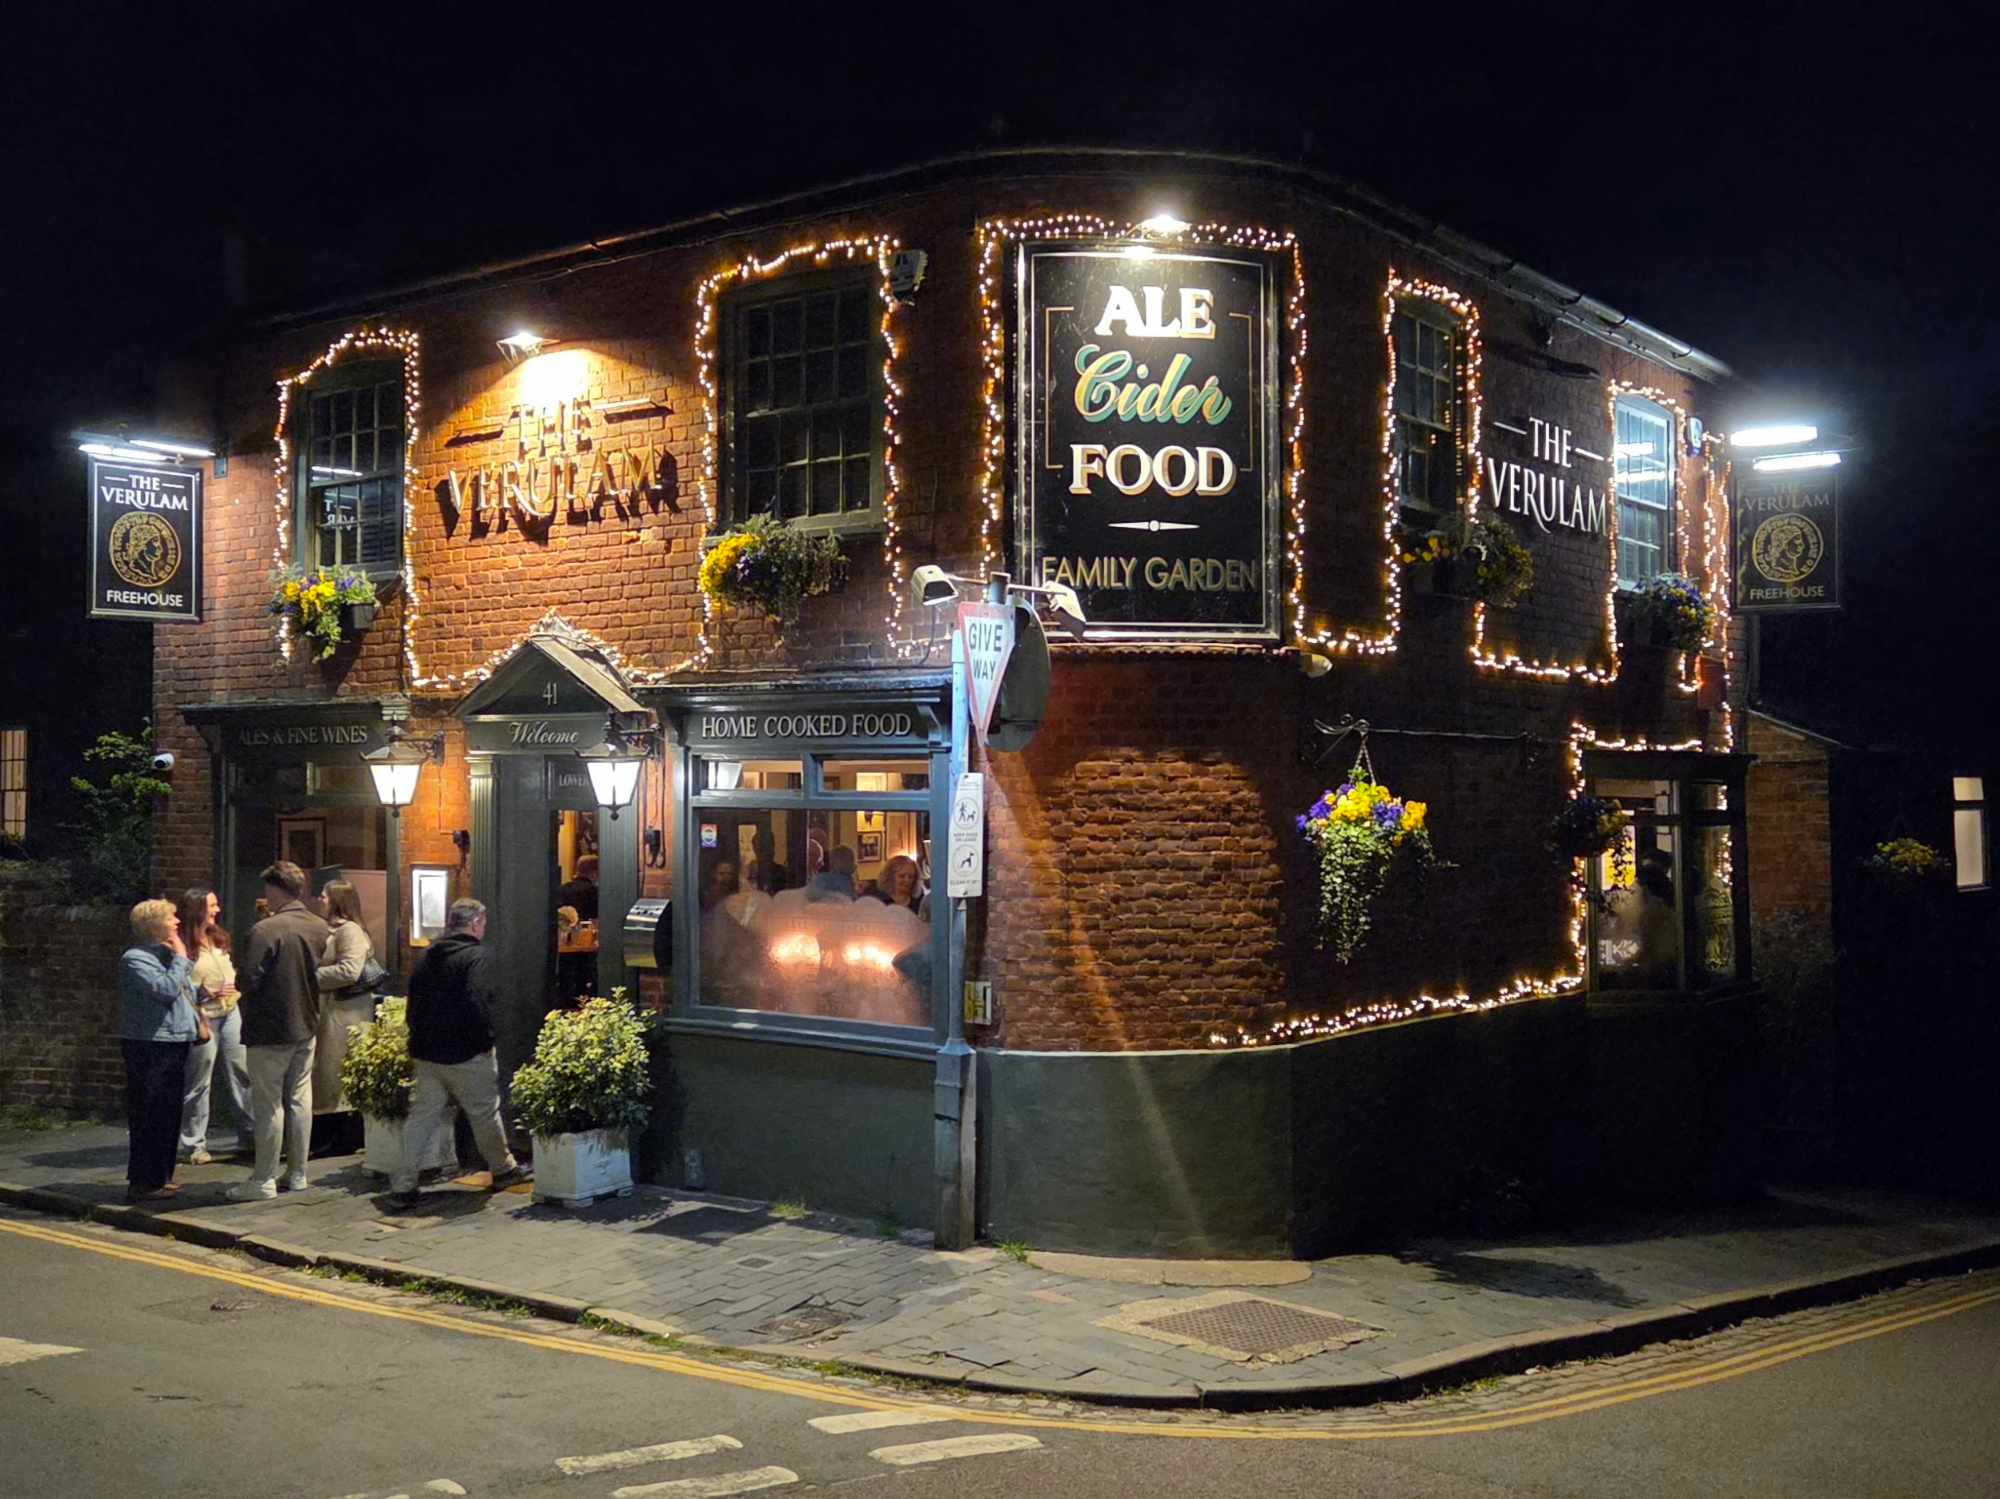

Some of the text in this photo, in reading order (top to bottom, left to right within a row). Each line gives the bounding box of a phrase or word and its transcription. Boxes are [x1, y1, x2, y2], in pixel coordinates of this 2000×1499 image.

[1094, 285, 1216, 340] ALE
[1074, 343, 1232, 425] Cider
[510, 398, 593, 453] THE
[1529, 417, 1572, 468] THE
[129, 474, 160, 491] THE
[448, 437, 662, 517] VERULAM
[1070, 443, 1237, 497] FOOD
[101, 486, 188, 510] VERULAM
[1487, 457, 1608, 537] VERULAM
[1744, 492, 1830, 512] VERULAM
[1041, 556, 1260, 593] FAMILY GARDEN
[106, 589, 183, 606] FREEHOUSE
[1749, 584, 1825, 601] FREEHOUSE
[968, 623, 1003, 653] GIVE
[973, 658, 996, 681] WAY
[542, 681, 559, 706] 41
[287, 727, 319, 744] FINE
[321, 725, 369, 743] WINES
[509, 721, 578, 745] Welcome
[702, 712, 911, 738] HOME COOKED FOOD
